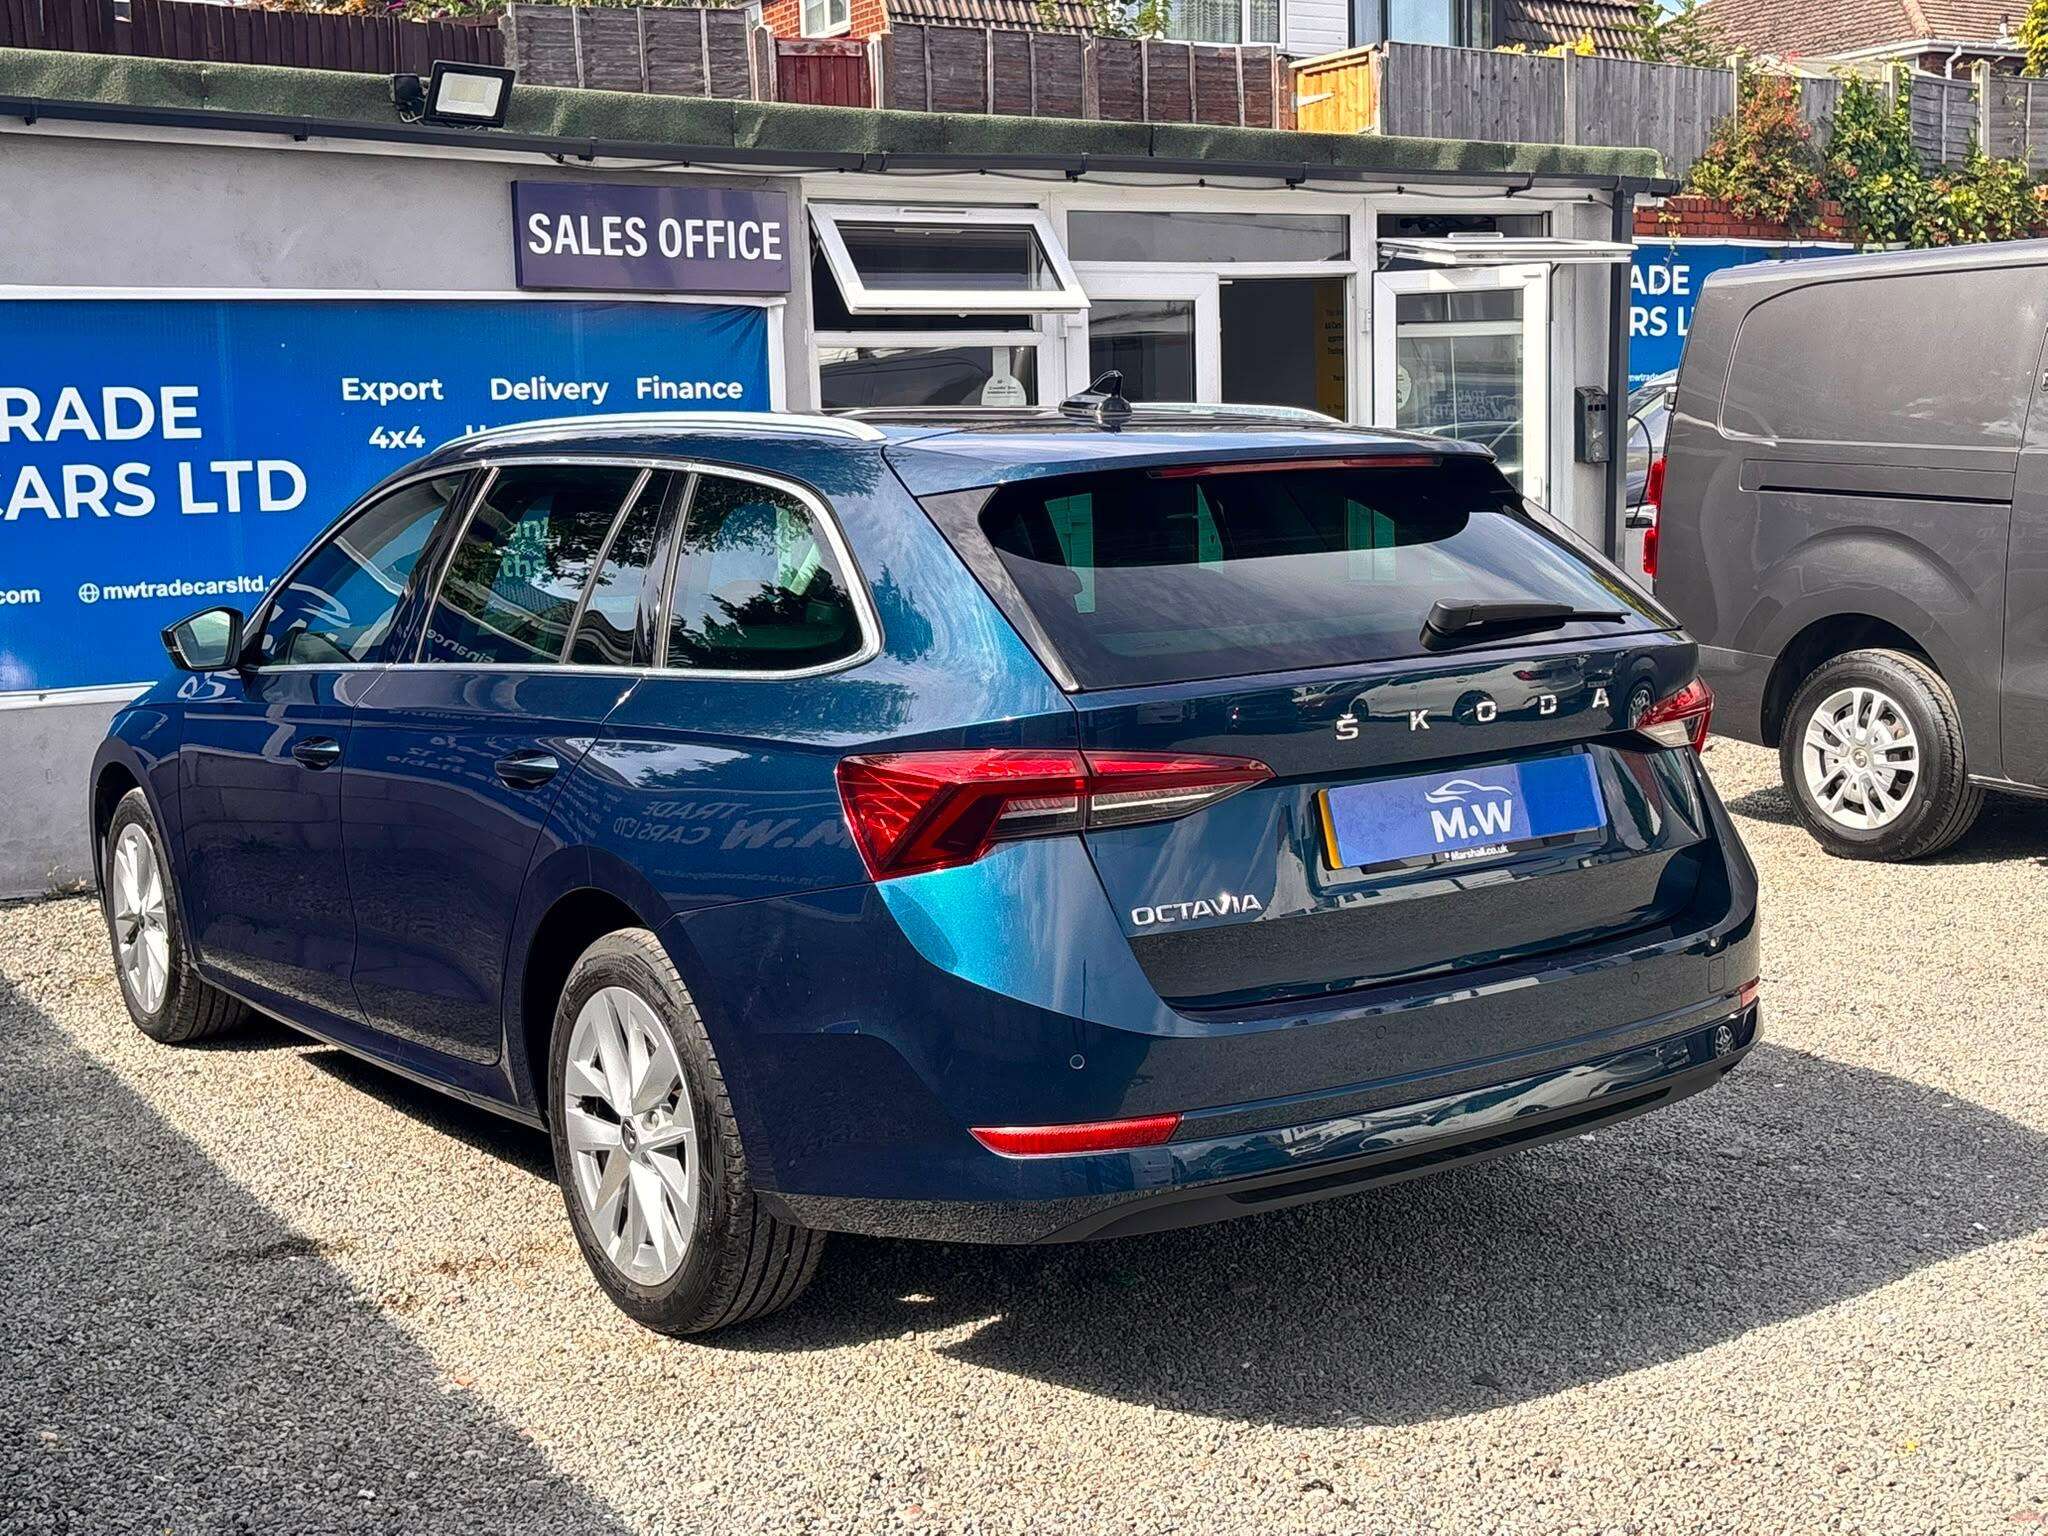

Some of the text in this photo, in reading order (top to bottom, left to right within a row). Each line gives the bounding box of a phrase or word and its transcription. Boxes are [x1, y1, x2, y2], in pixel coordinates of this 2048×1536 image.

[528, 212, 783, 262] SALES OFFICE
[341, 375, 744, 405] Export Delivery Finance
[0, 386, 202, 442] RADE
[368, 425, 426, 450] 4x4
[0, 459, 307, 521] ARS LTD
[1336, 688, 1610, 741] ŠKODA
[1430, 800, 1513, 843] M.W
[1131, 892, 1263, 928] OCTAVIA
